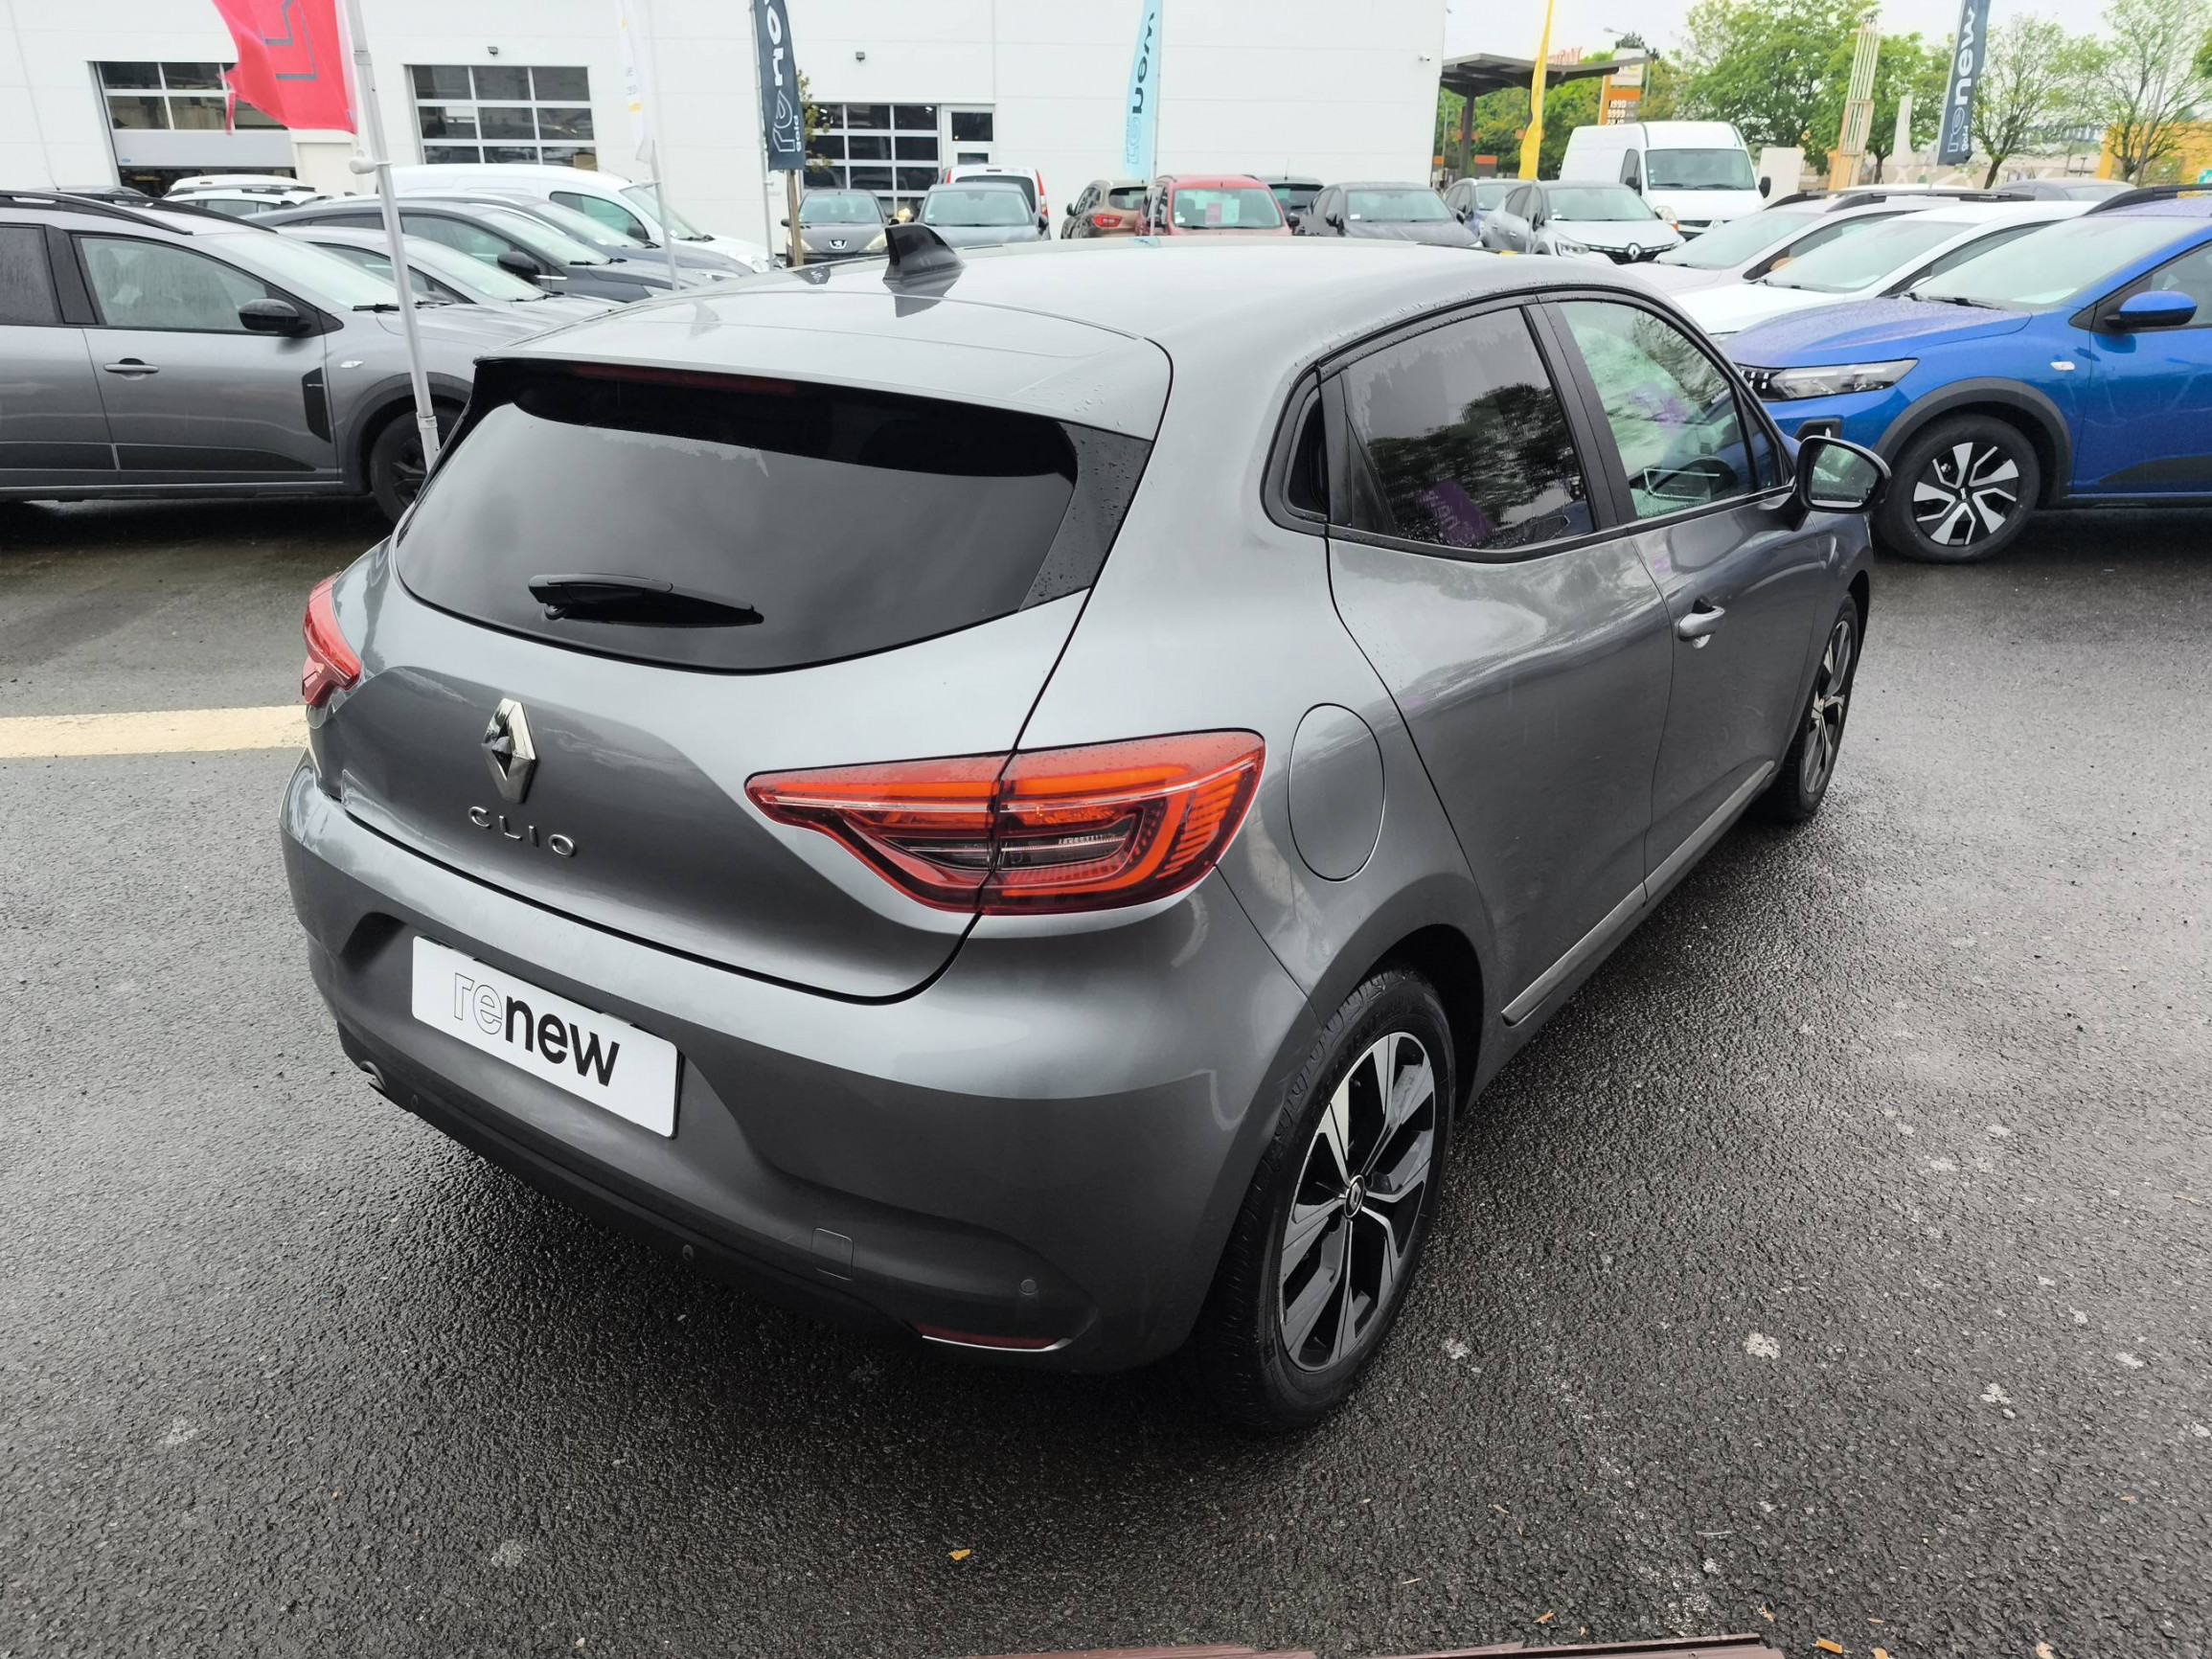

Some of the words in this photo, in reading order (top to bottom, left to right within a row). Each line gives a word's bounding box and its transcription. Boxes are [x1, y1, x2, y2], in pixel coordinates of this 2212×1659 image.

[764, 0, 795, 151] rene
[1948, 6, 1975, 152] renew
[1961, 125, 1970, 151] gold
[468, 806, 575, 857] CLIO
[454, 972, 620, 1087] renew
